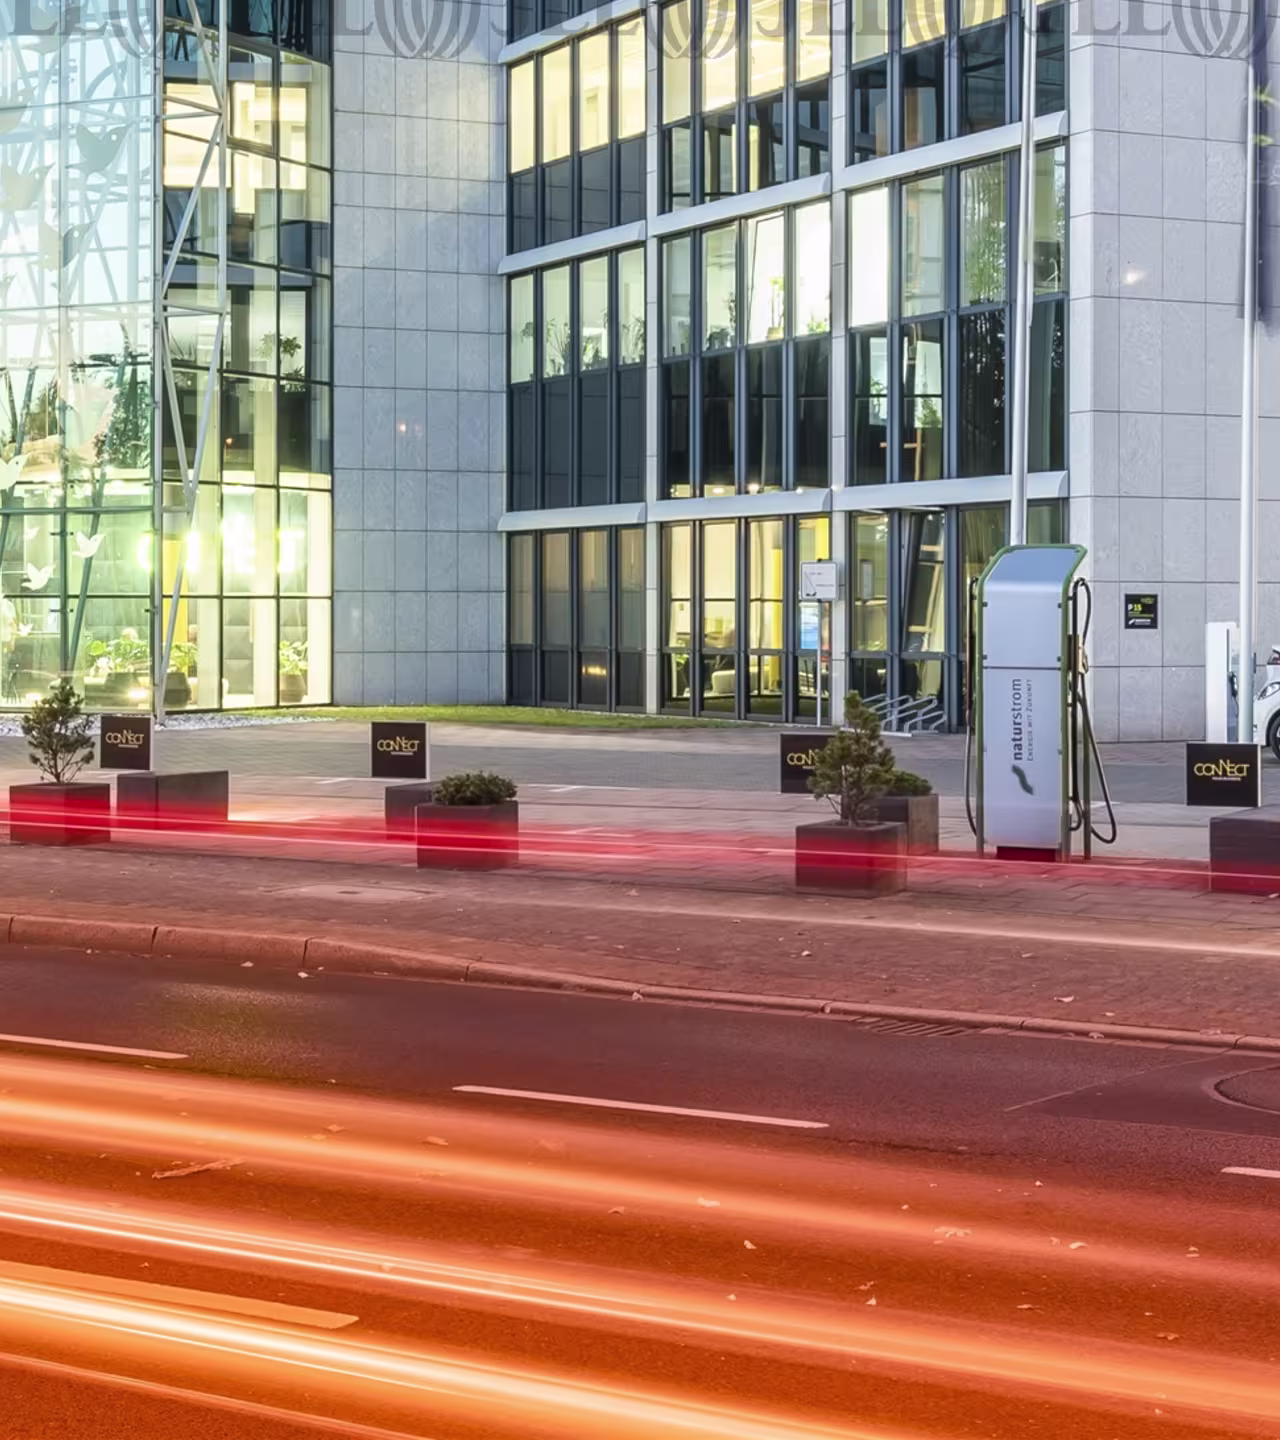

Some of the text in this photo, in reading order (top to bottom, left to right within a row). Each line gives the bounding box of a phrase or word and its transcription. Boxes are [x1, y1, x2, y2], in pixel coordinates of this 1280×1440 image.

[1011, 679, 1023, 761] naturstrom
[105, 729, 145, 745] CONNECT
[377, 736, 420, 752] CONNECT
[1193, 759, 1250, 777] CONNECT
